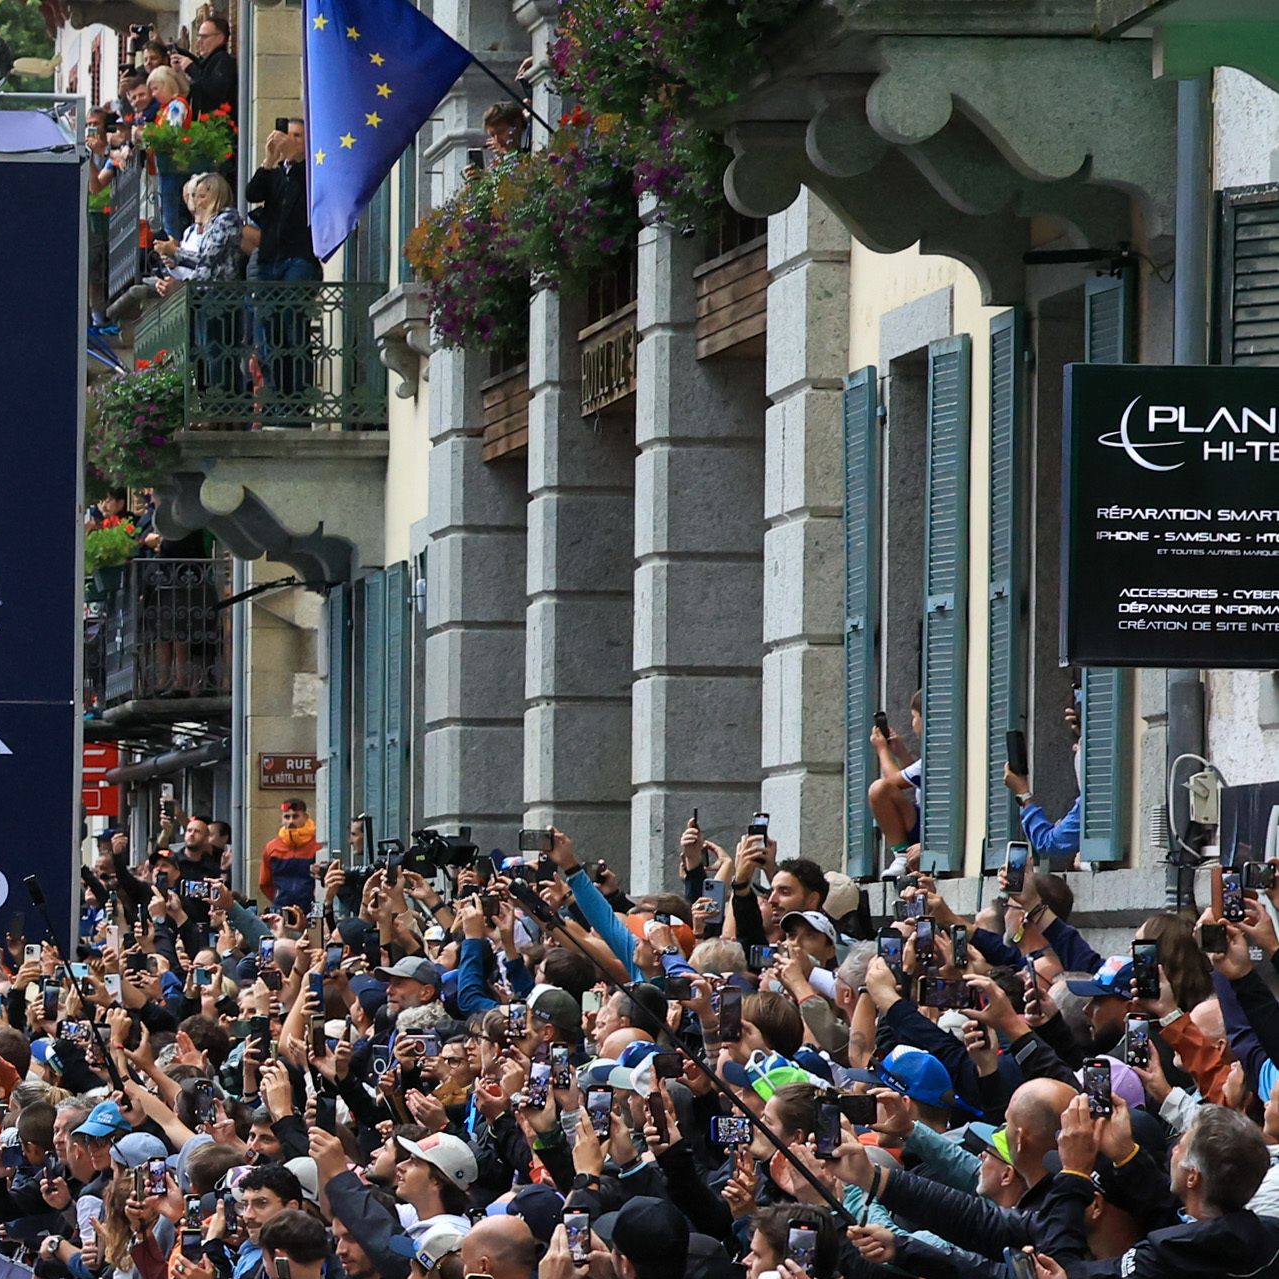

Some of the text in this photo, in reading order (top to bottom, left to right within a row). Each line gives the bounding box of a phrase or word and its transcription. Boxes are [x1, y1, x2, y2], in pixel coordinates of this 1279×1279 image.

[1097, 505, 1211, 520] RÉPARATION
[1096, 531, 1149, 541] IPHONE
[1165, 532, 1241, 543] SAMSUNG
[1119, 588, 1218, 599] ACCESSOIRES
[1119, 601, 1211, 615] DÉPANNAGE
[1118, 619, 1188, 631] CRÉATION
[1192, 621, 1211, 631] DE
[1216, 622, 1247, 631] SITE
[286, 759, 312, 770] RUE
